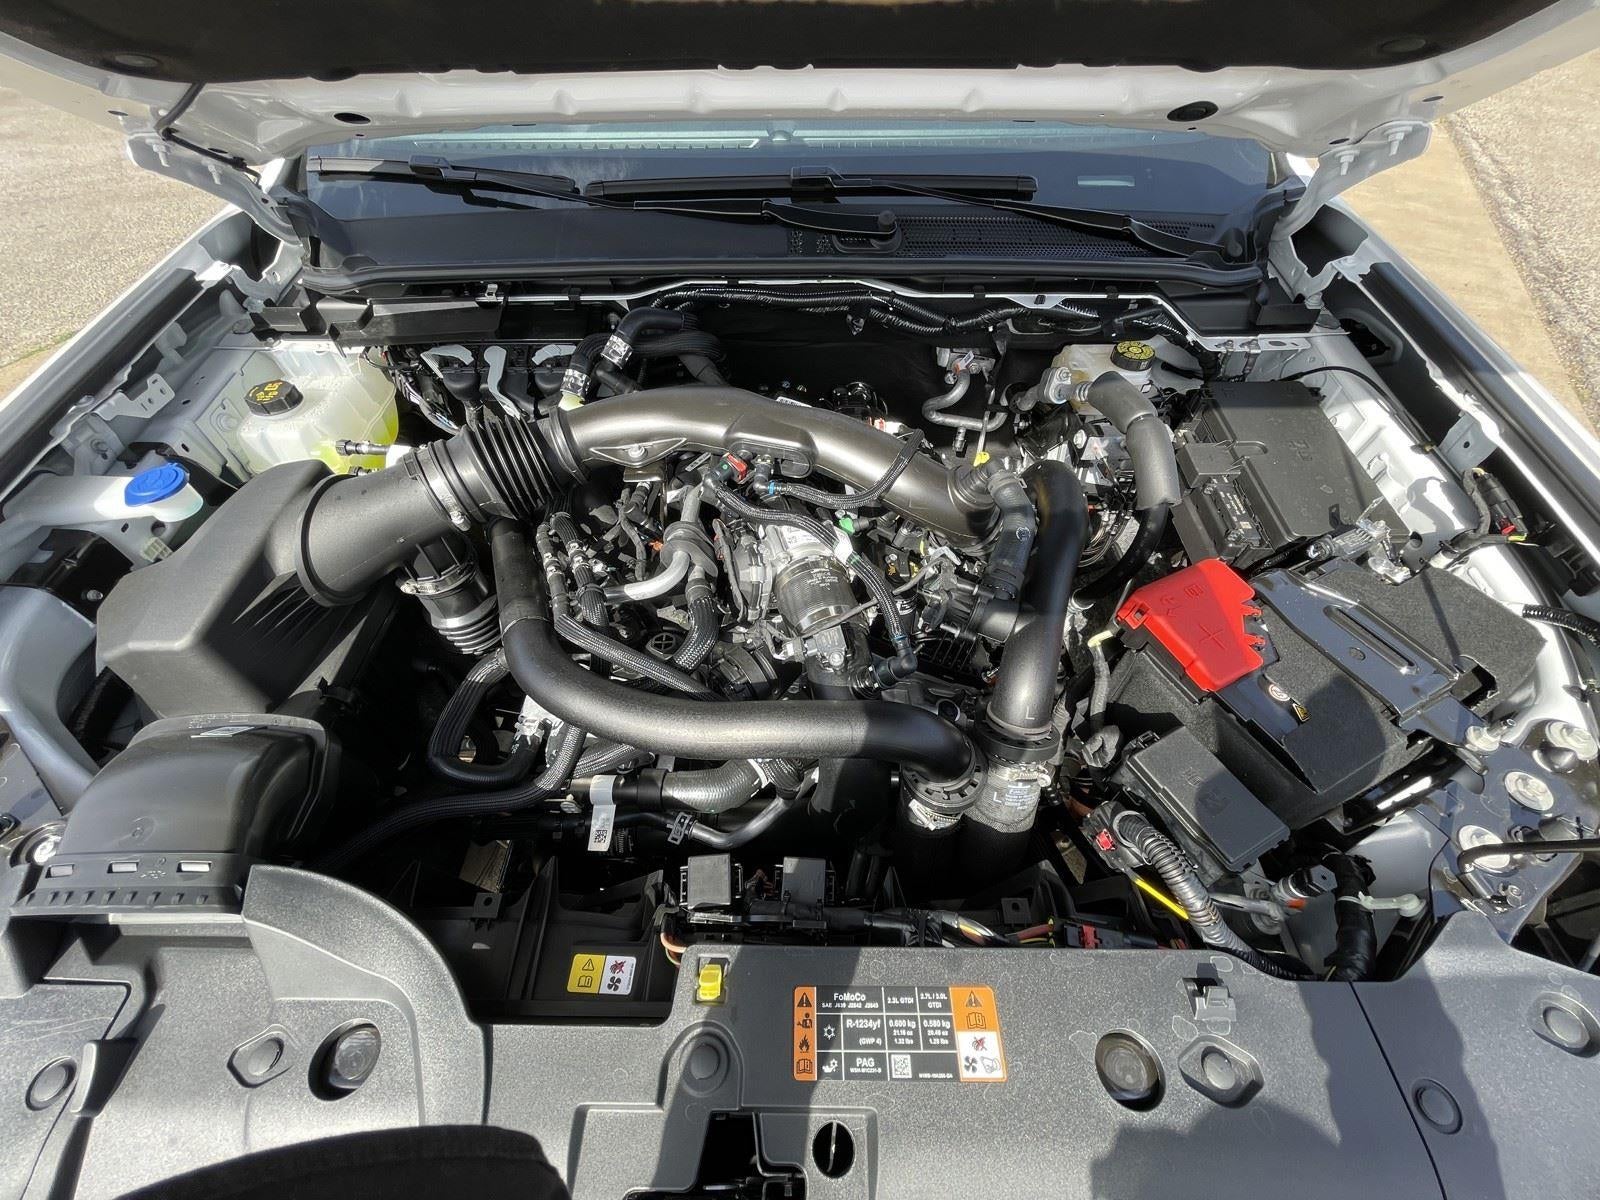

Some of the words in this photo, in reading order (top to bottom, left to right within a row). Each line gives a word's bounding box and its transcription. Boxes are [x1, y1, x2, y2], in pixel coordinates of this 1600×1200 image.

[833, 992, 866, 1001] FoMoCo
[846, 1019, 881, 1030] R-1234yf
[889, 1019, 906, 1028] 0.600
[907, 1019, 916, 1029] kg
[923, 1019, 940, 1028] 0.580
[941, 1019, 950, 1029] kg
[859, 1037, 875, 1046] (GWP
[876, 1037, 882, 1046] 4)
[856, 1057, 875, 1067] PAG
